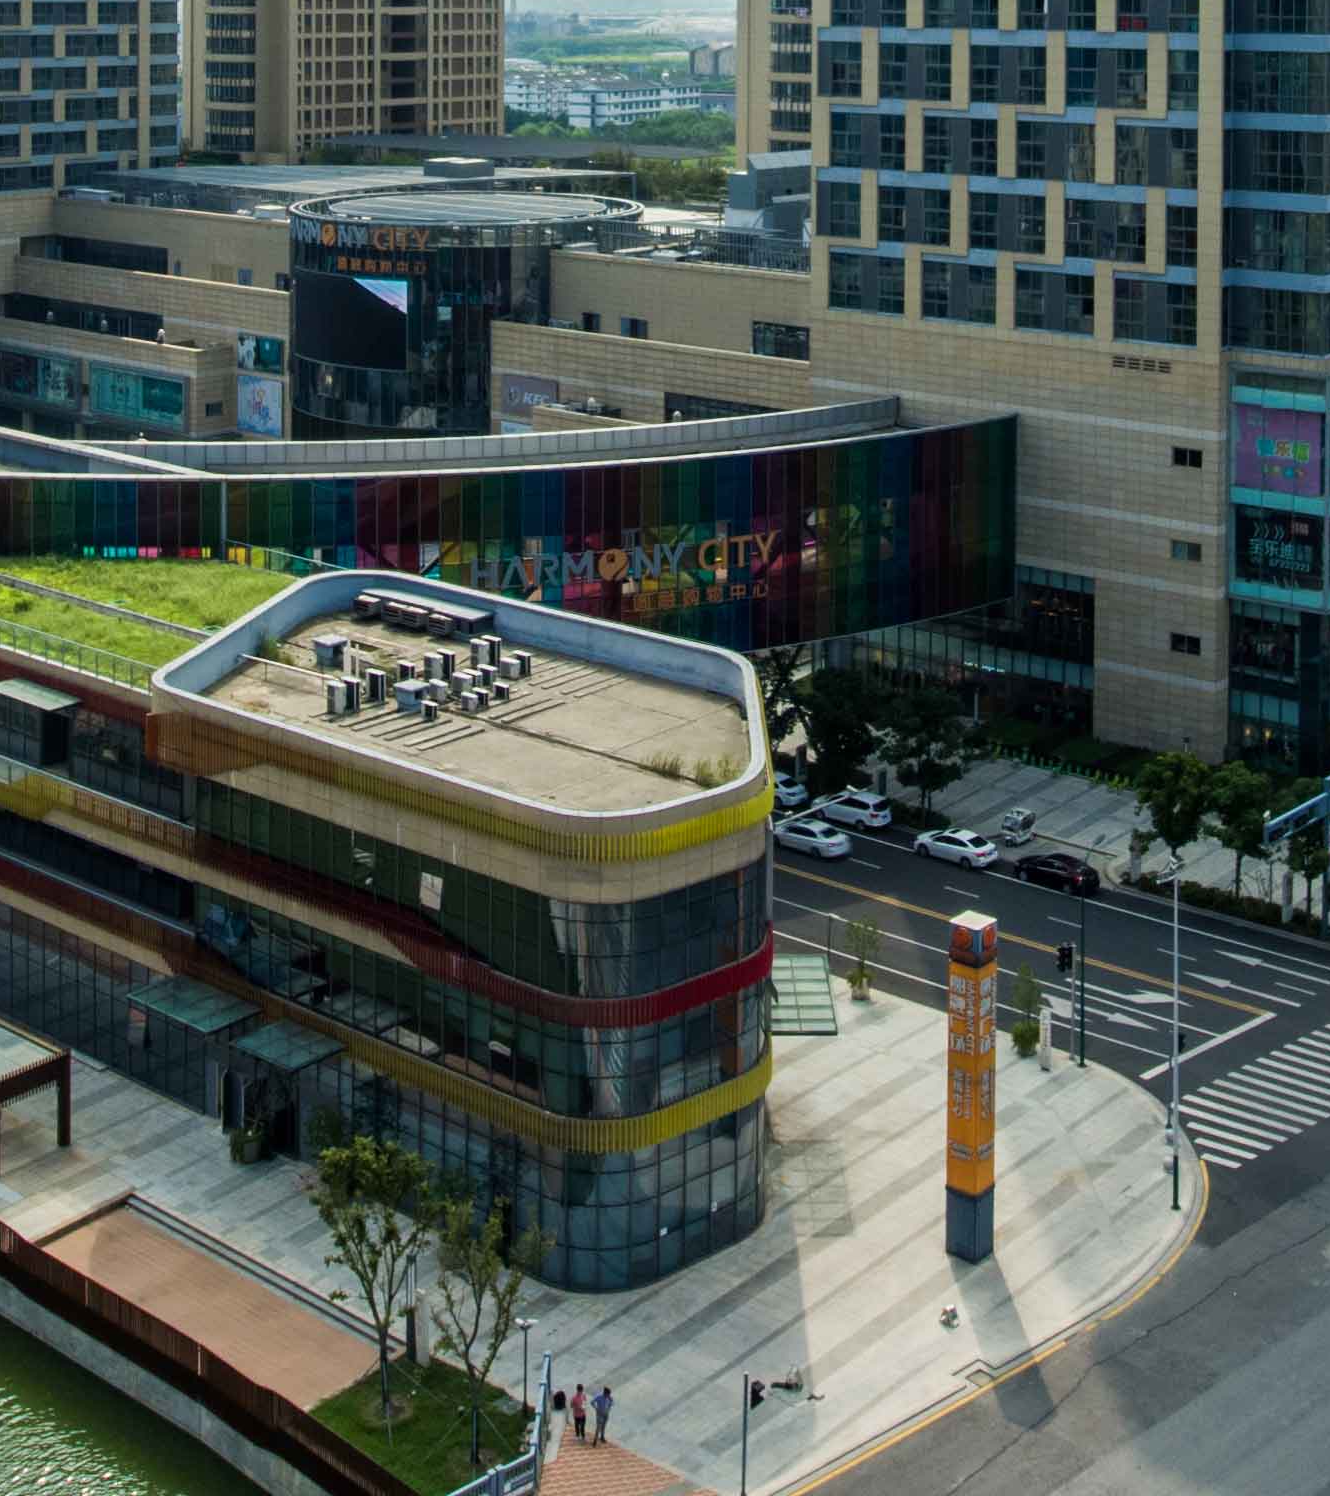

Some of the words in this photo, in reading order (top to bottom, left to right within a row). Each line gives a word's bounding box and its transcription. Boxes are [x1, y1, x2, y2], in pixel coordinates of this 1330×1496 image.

[372, 227, 430, 251] CITY
[470, 543, 686, 591] HARMONY
[697, 529, 782, 572] CITY
